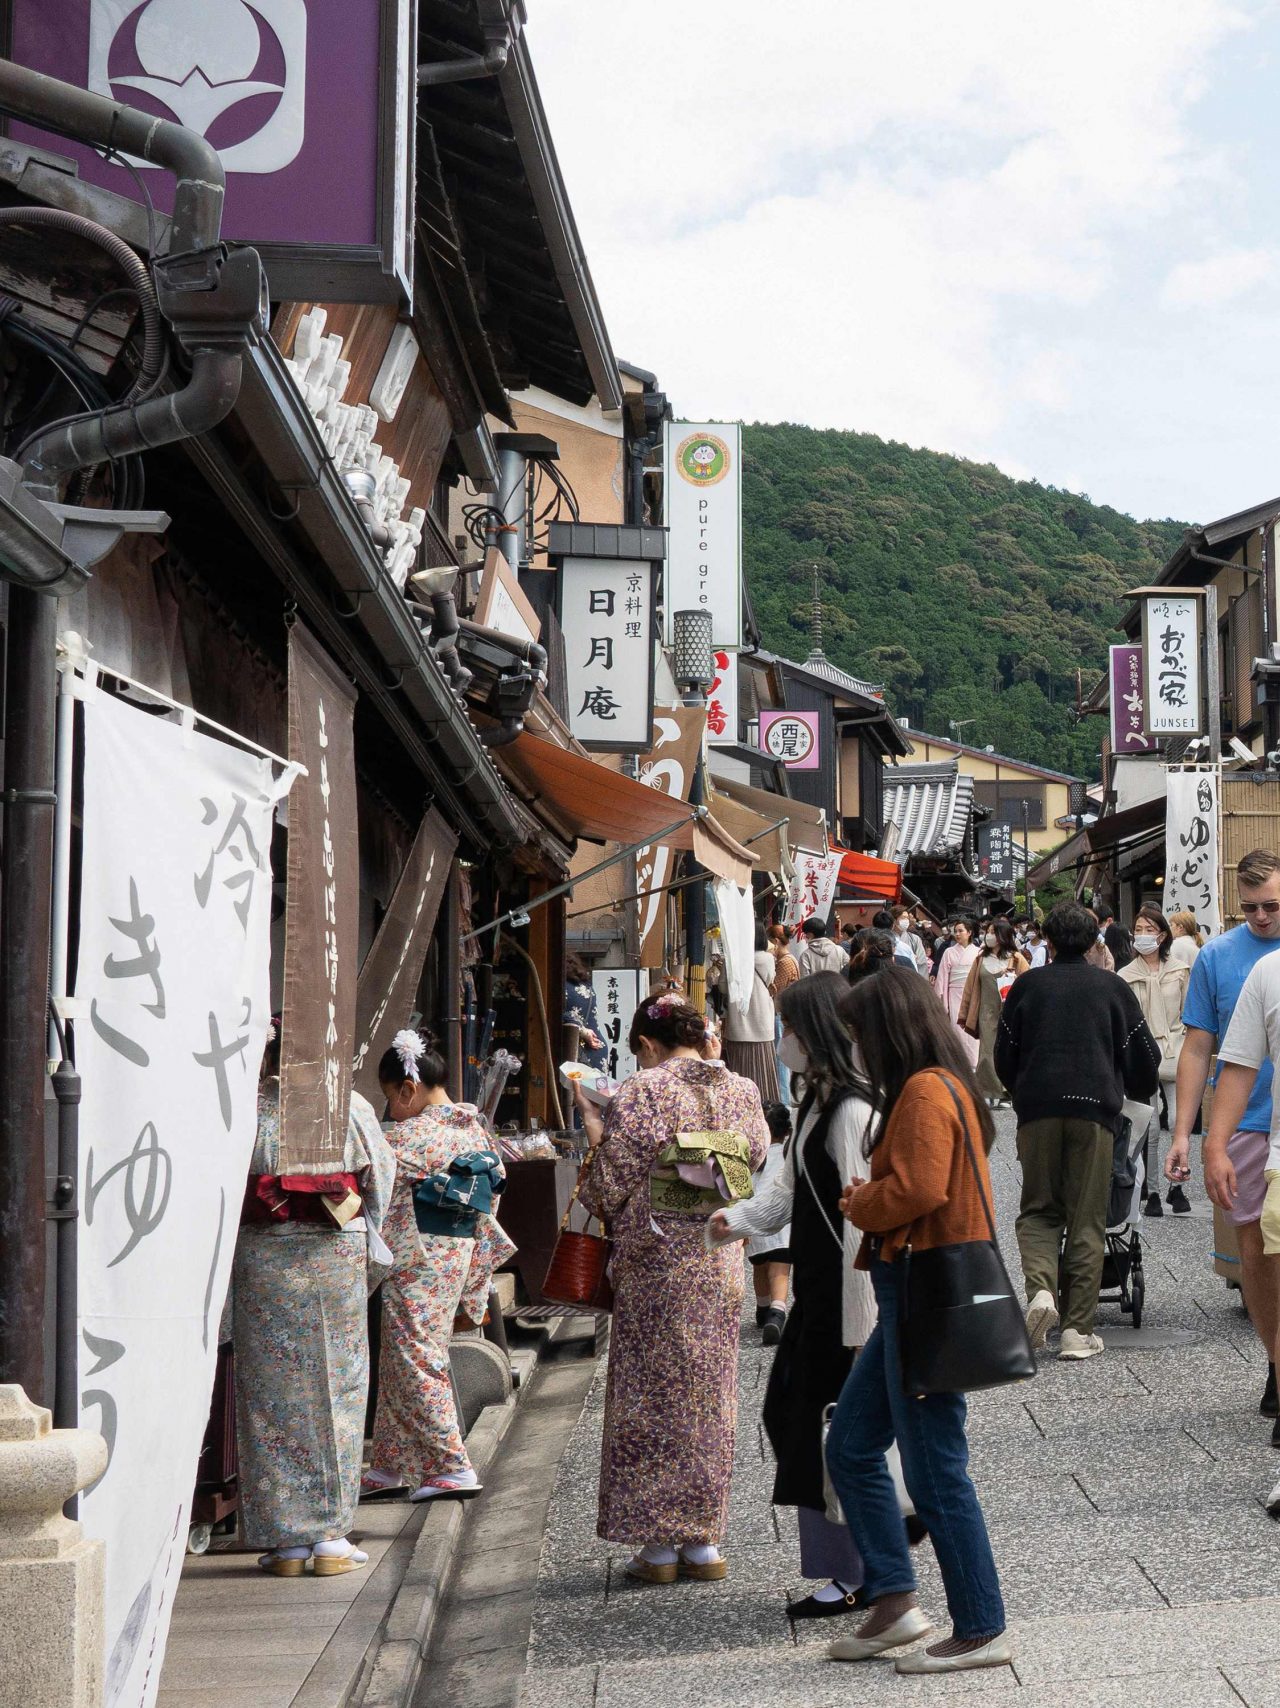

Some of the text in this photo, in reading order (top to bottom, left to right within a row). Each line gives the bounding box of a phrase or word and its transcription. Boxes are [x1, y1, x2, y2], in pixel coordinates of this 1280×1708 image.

[698, 499, 708, 551] pure
[624, 572, 643, 638] 京料理
[577, 589, 622, 721] 日月庵
[1158, 624, 1188, 708] おかべ家
[780, 724, 799, 756] 西尾
[1154, 718, 1195, 728] JUNSEI
[1168, 863, 1180, 898] 清水寺
[607, 976, 620, 1015] 京料理
